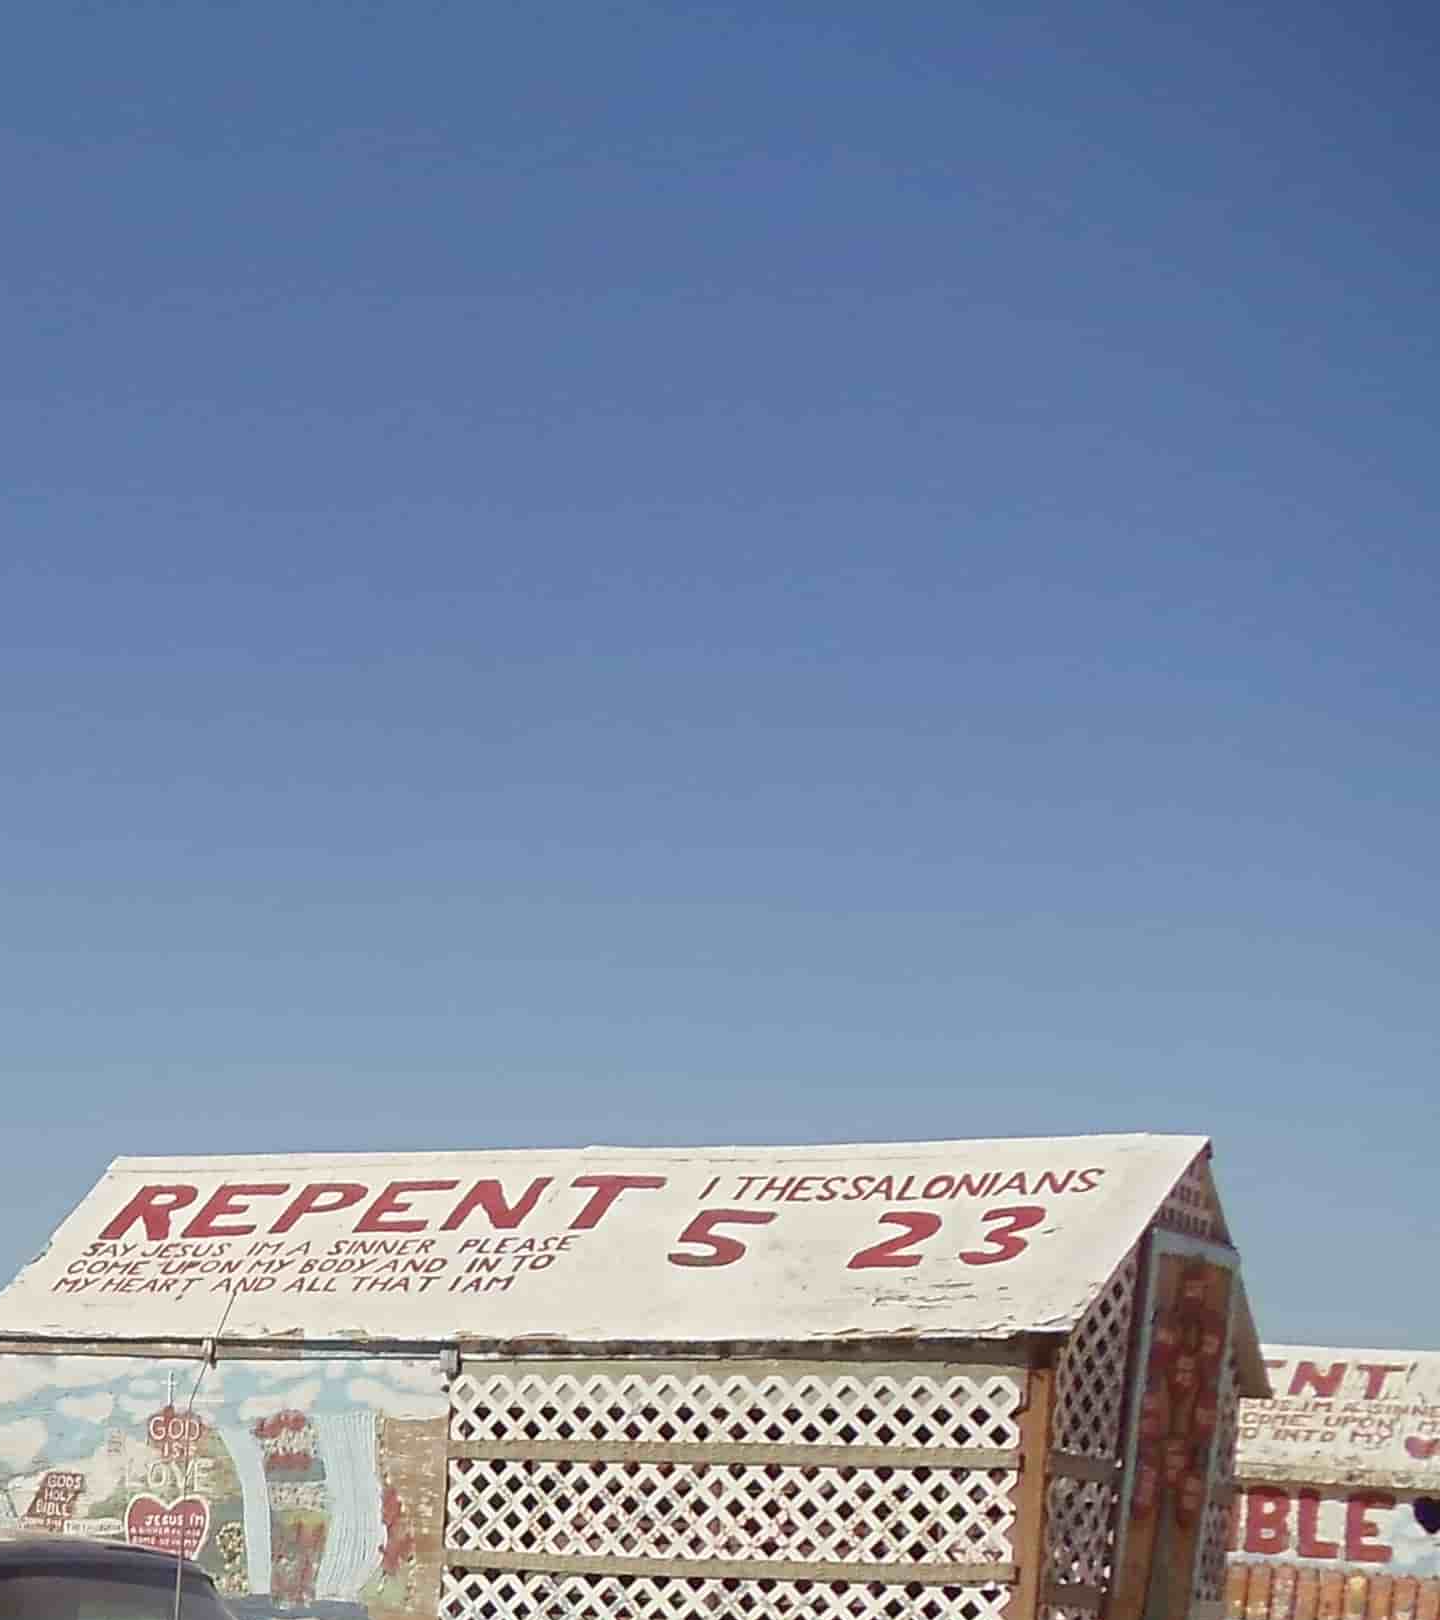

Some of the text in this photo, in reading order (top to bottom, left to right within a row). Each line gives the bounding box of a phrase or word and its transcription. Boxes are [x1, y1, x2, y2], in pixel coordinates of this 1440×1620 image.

[736, 1168, 1107, 1202] THESSALONIANS
[98, 1175, 667, 1242] REPENT
[82, 1240, 130, 1257] SAY
[142, 1241, 232, 1259] JESUS
[291, 1240, 312, 1257] A
[327, 1239, 437, 1257] SINNER
[458, 1234, 580, 1255] PLEASE
[668, 1209, 777, 1267] 5
[66, 1253, 557, 1276] COME UPON MY BODY AND IN TO
[50, 1277, 100, 1294] MY
[102, 1276, 206, 1294] HEART
[210, 1276, 275, 1294] AND
[287, 1276, 339, 1293] ALL
[351, 1275, 438, 1293] THAT
[149, 1416, 201, 1441] GOD
[125, 1458, 211, 1491] LOVE
[144, 1514, 185, 1527] JESUS
